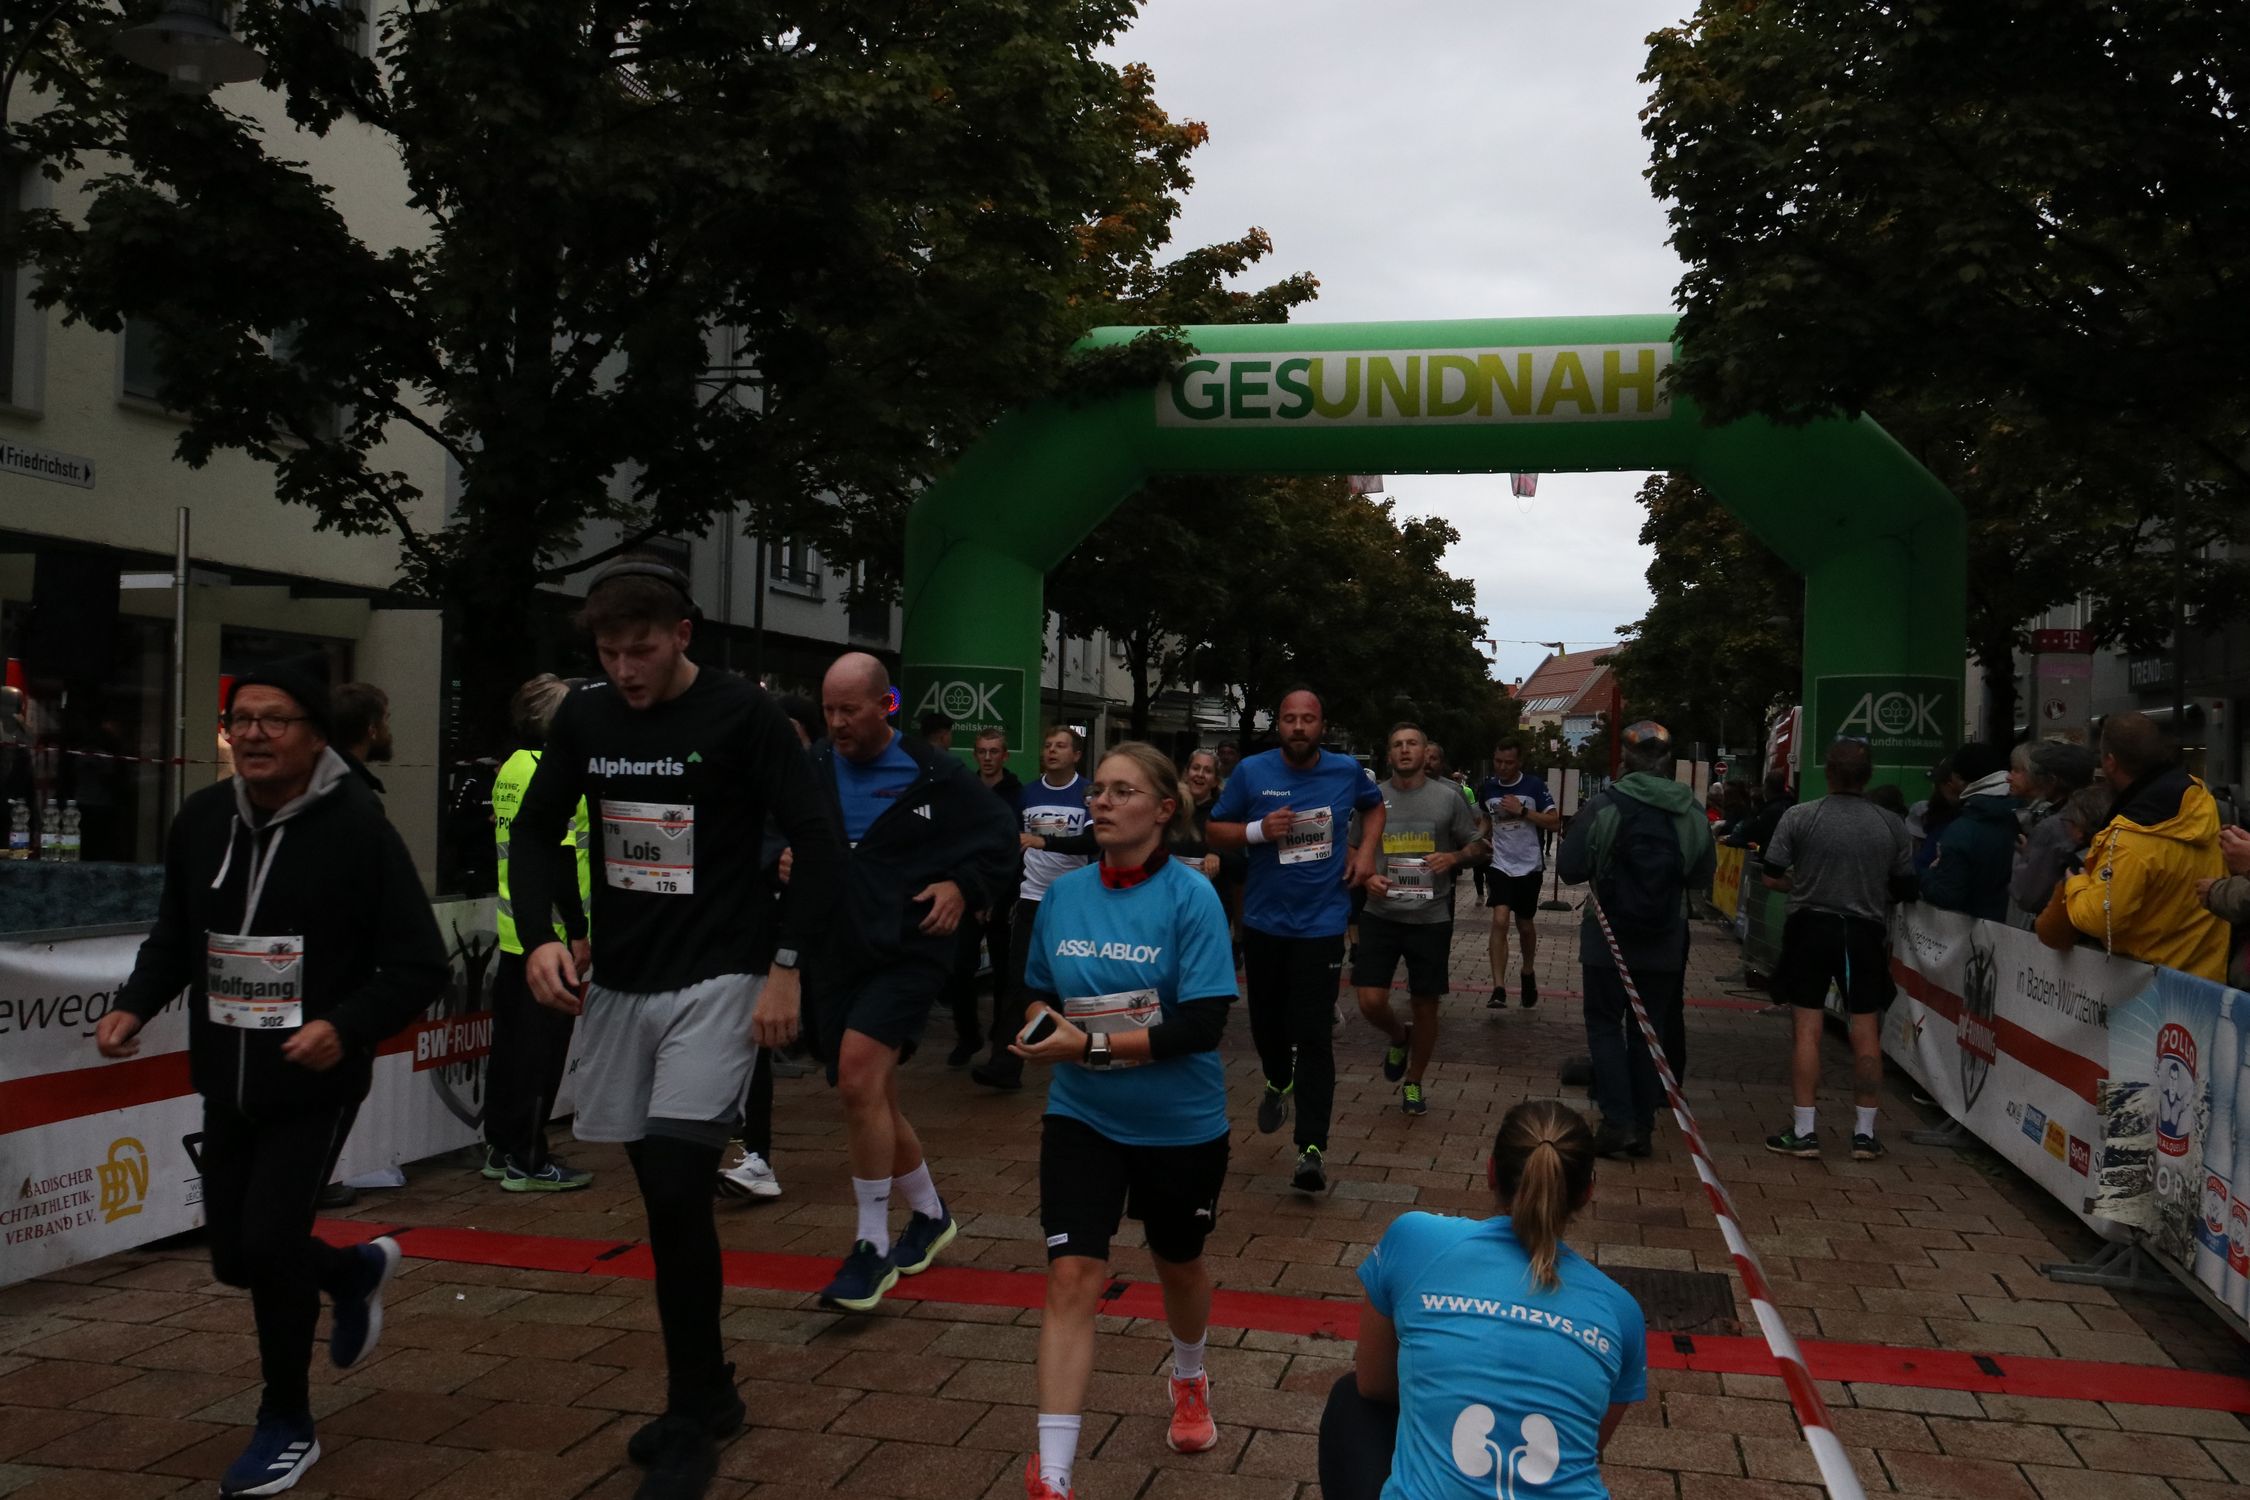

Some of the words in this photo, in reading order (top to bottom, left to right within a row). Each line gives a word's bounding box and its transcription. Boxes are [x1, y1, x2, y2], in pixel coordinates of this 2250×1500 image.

[1171, 349, 1655, 421] GESUNDNAH
[7, 446, 81, 480] Friedrichstr.
[913, 681, 1004, 721] AOK
[1836, 691, 1943, 736] AOK
[587, 756, 685, 778] Alphartis
[1262, 789, 1292, 797] uhlsport
[623, 839, 662, 862] Lois
[1286, 832, 1325, 846] Holger
[655, 880, 678, 893] 176
[1399, 875, 1420, 886] Willi
[1056, 940, 1097, 957] ASSA
[1099, 942, 1162, 964] ABLOY
[209, 976, 294, 1001] Wolfgang
[259, 1016, 285, 1028] 302
[25, 1168, 94, 1198] BADISCHER
[5, 1214, 73, 1246] VERBAND
[1421, 1293, 1610, 1353] www.nzvs.de
